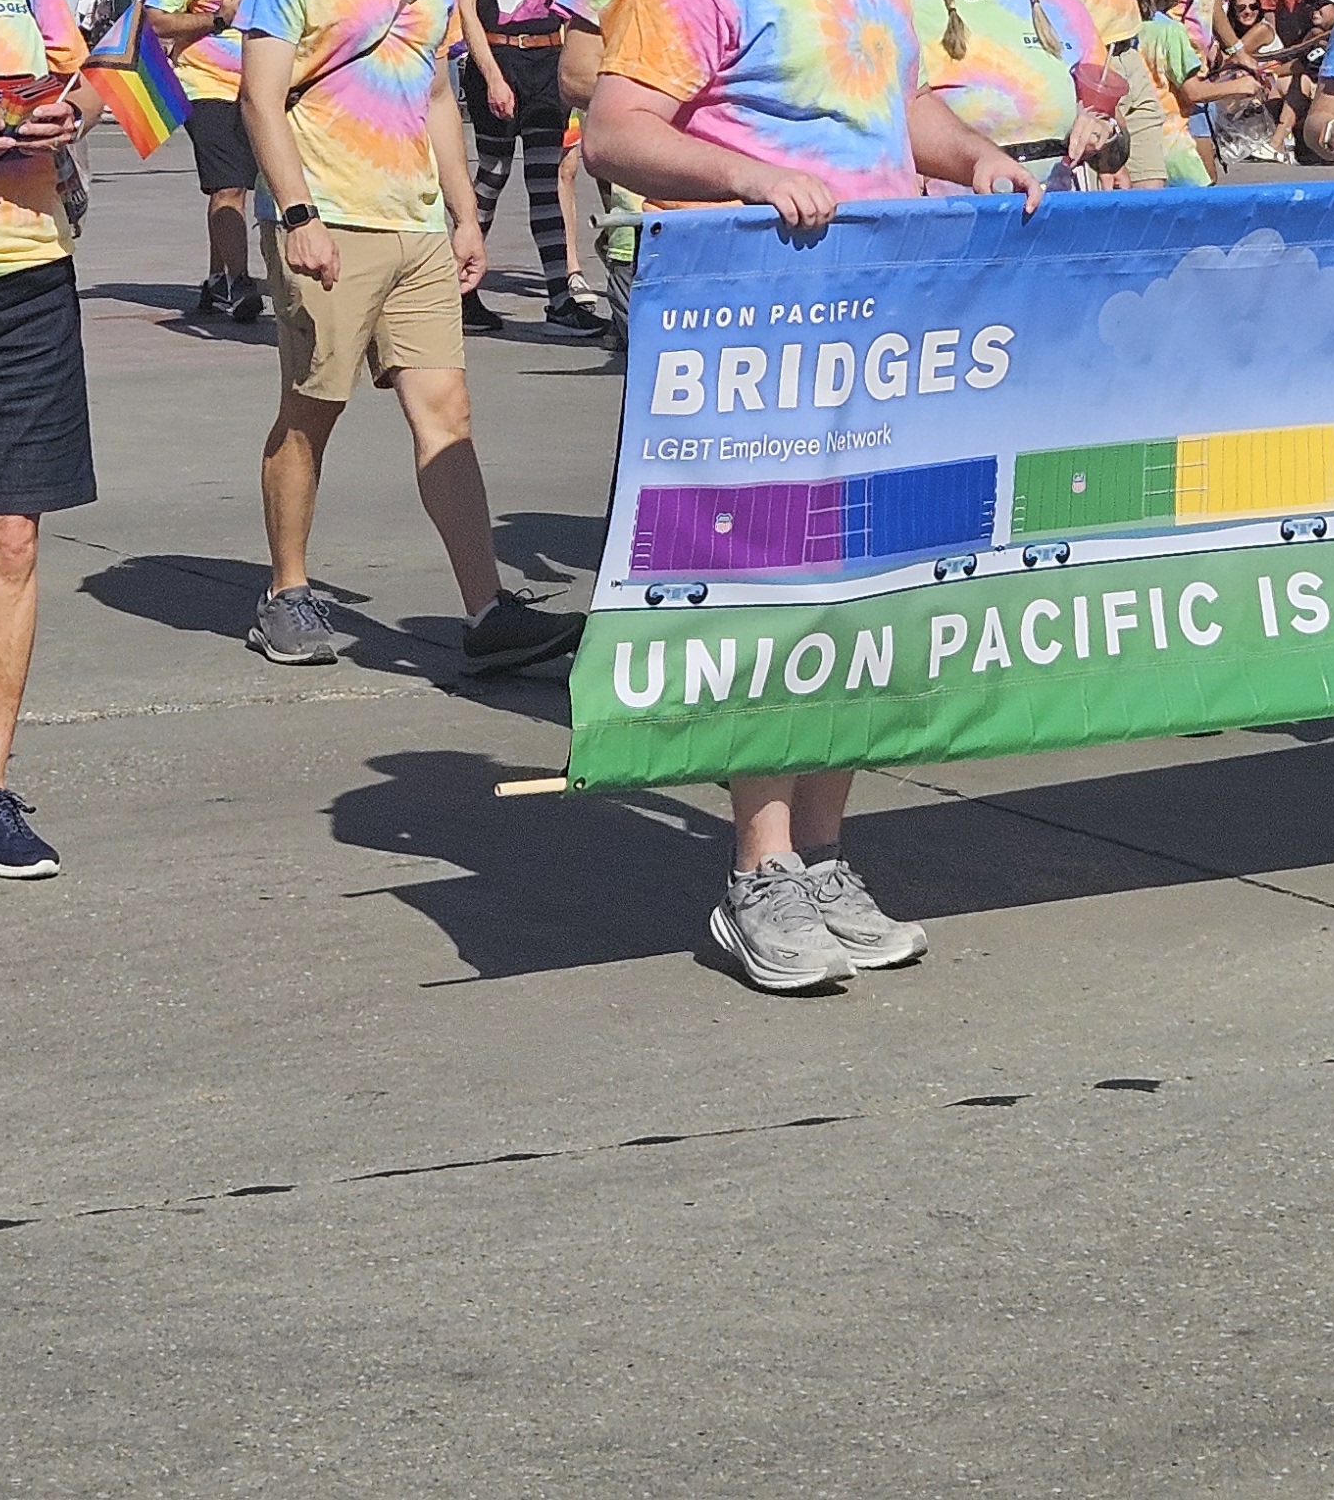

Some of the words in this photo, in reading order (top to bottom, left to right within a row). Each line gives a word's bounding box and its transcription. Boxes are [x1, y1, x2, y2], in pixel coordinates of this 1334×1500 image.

[662, 306, 756, 331] UNION
[769, 297, 876, 326] PACIFIC
[650, 325, 1015, 415] BRIDGES
[642, 438, 714, 461] LGBT
[720, 434, 820, 464] Employee
[825, 422, 892, 453] Network
[612, 625, 894, 708] UNION
[927, 581, 1224, 680] PACIFIC
[1257, 571, 1331, 638] IS
